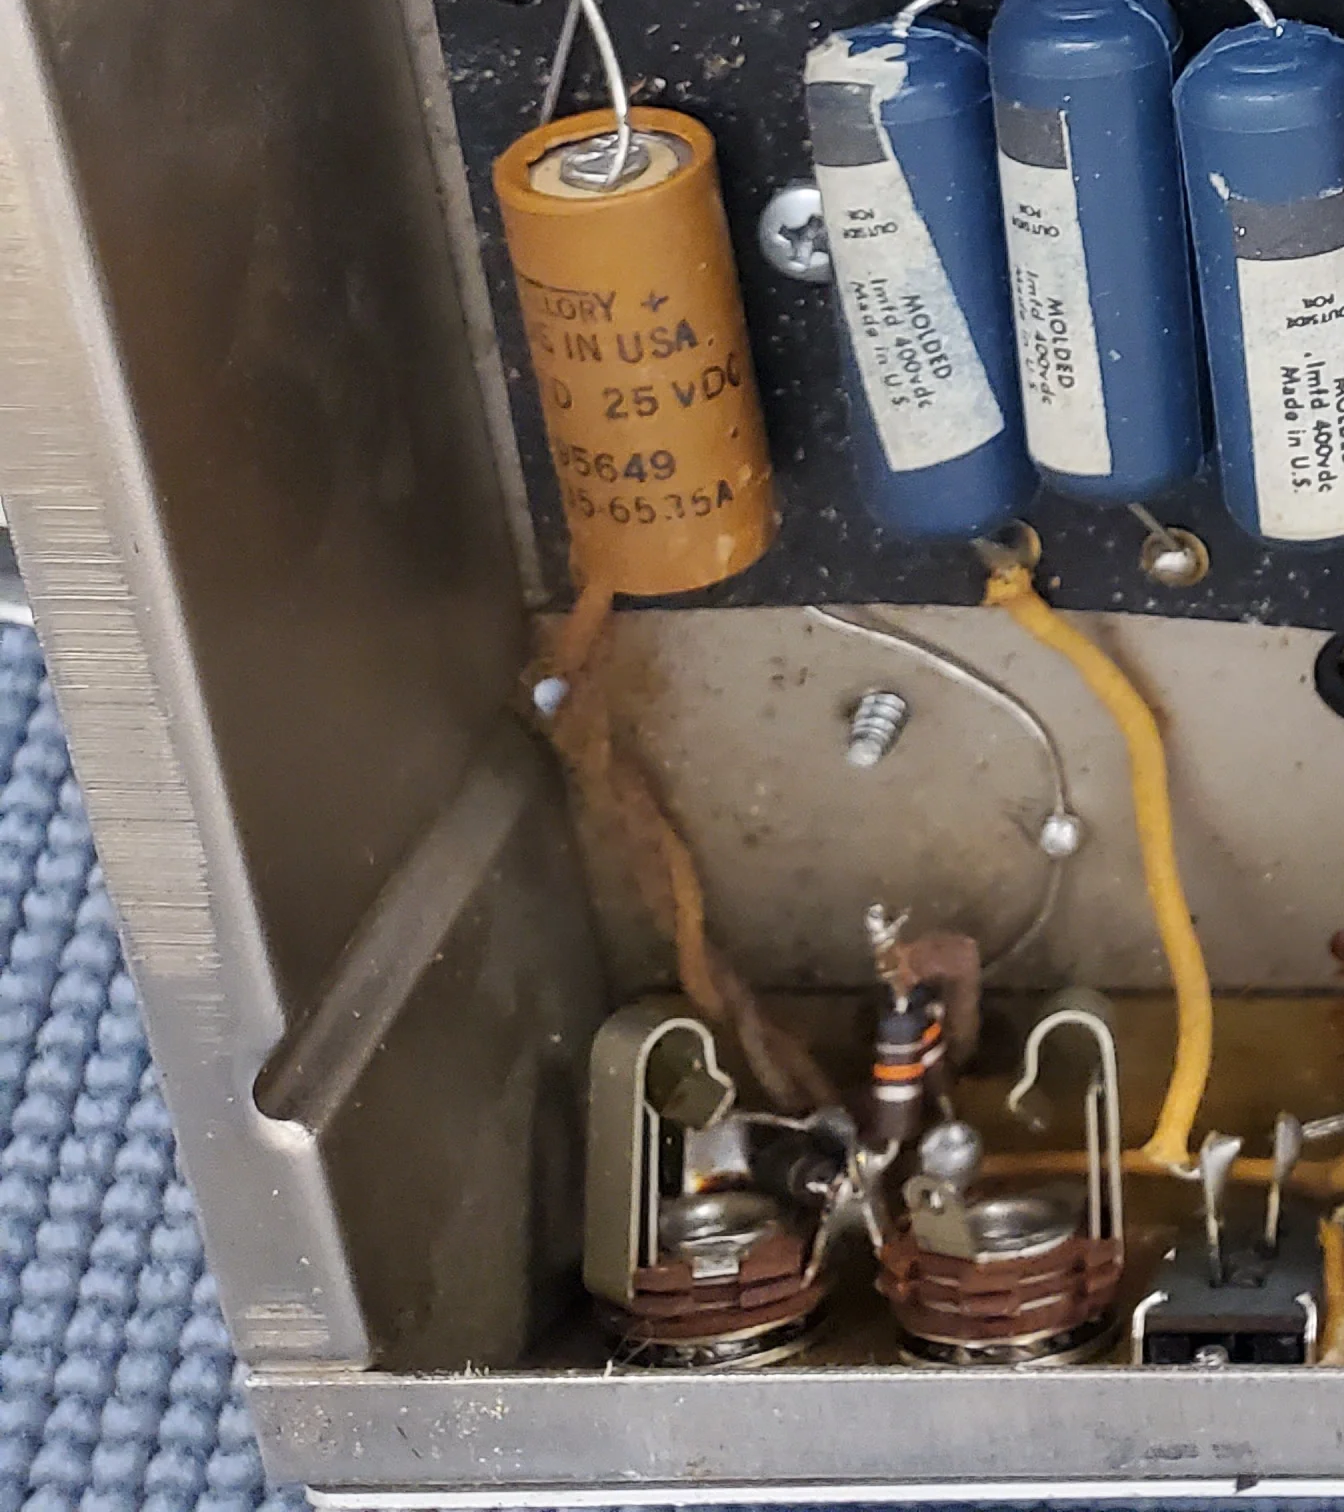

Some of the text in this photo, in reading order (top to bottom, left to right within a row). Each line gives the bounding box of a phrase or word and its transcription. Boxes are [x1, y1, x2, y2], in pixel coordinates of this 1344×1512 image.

[563, 332, 603, 363] IN
[901, 294, 953, 381] MOLDED
[1046, 296, 1076, 390] MOLDED
[602, 385, 660, 420] 25
[1280, 365, 1305, 422] Made
[1287, 429, 1308, 448] in
[1312, 419, 1339, 493] 400vdc
